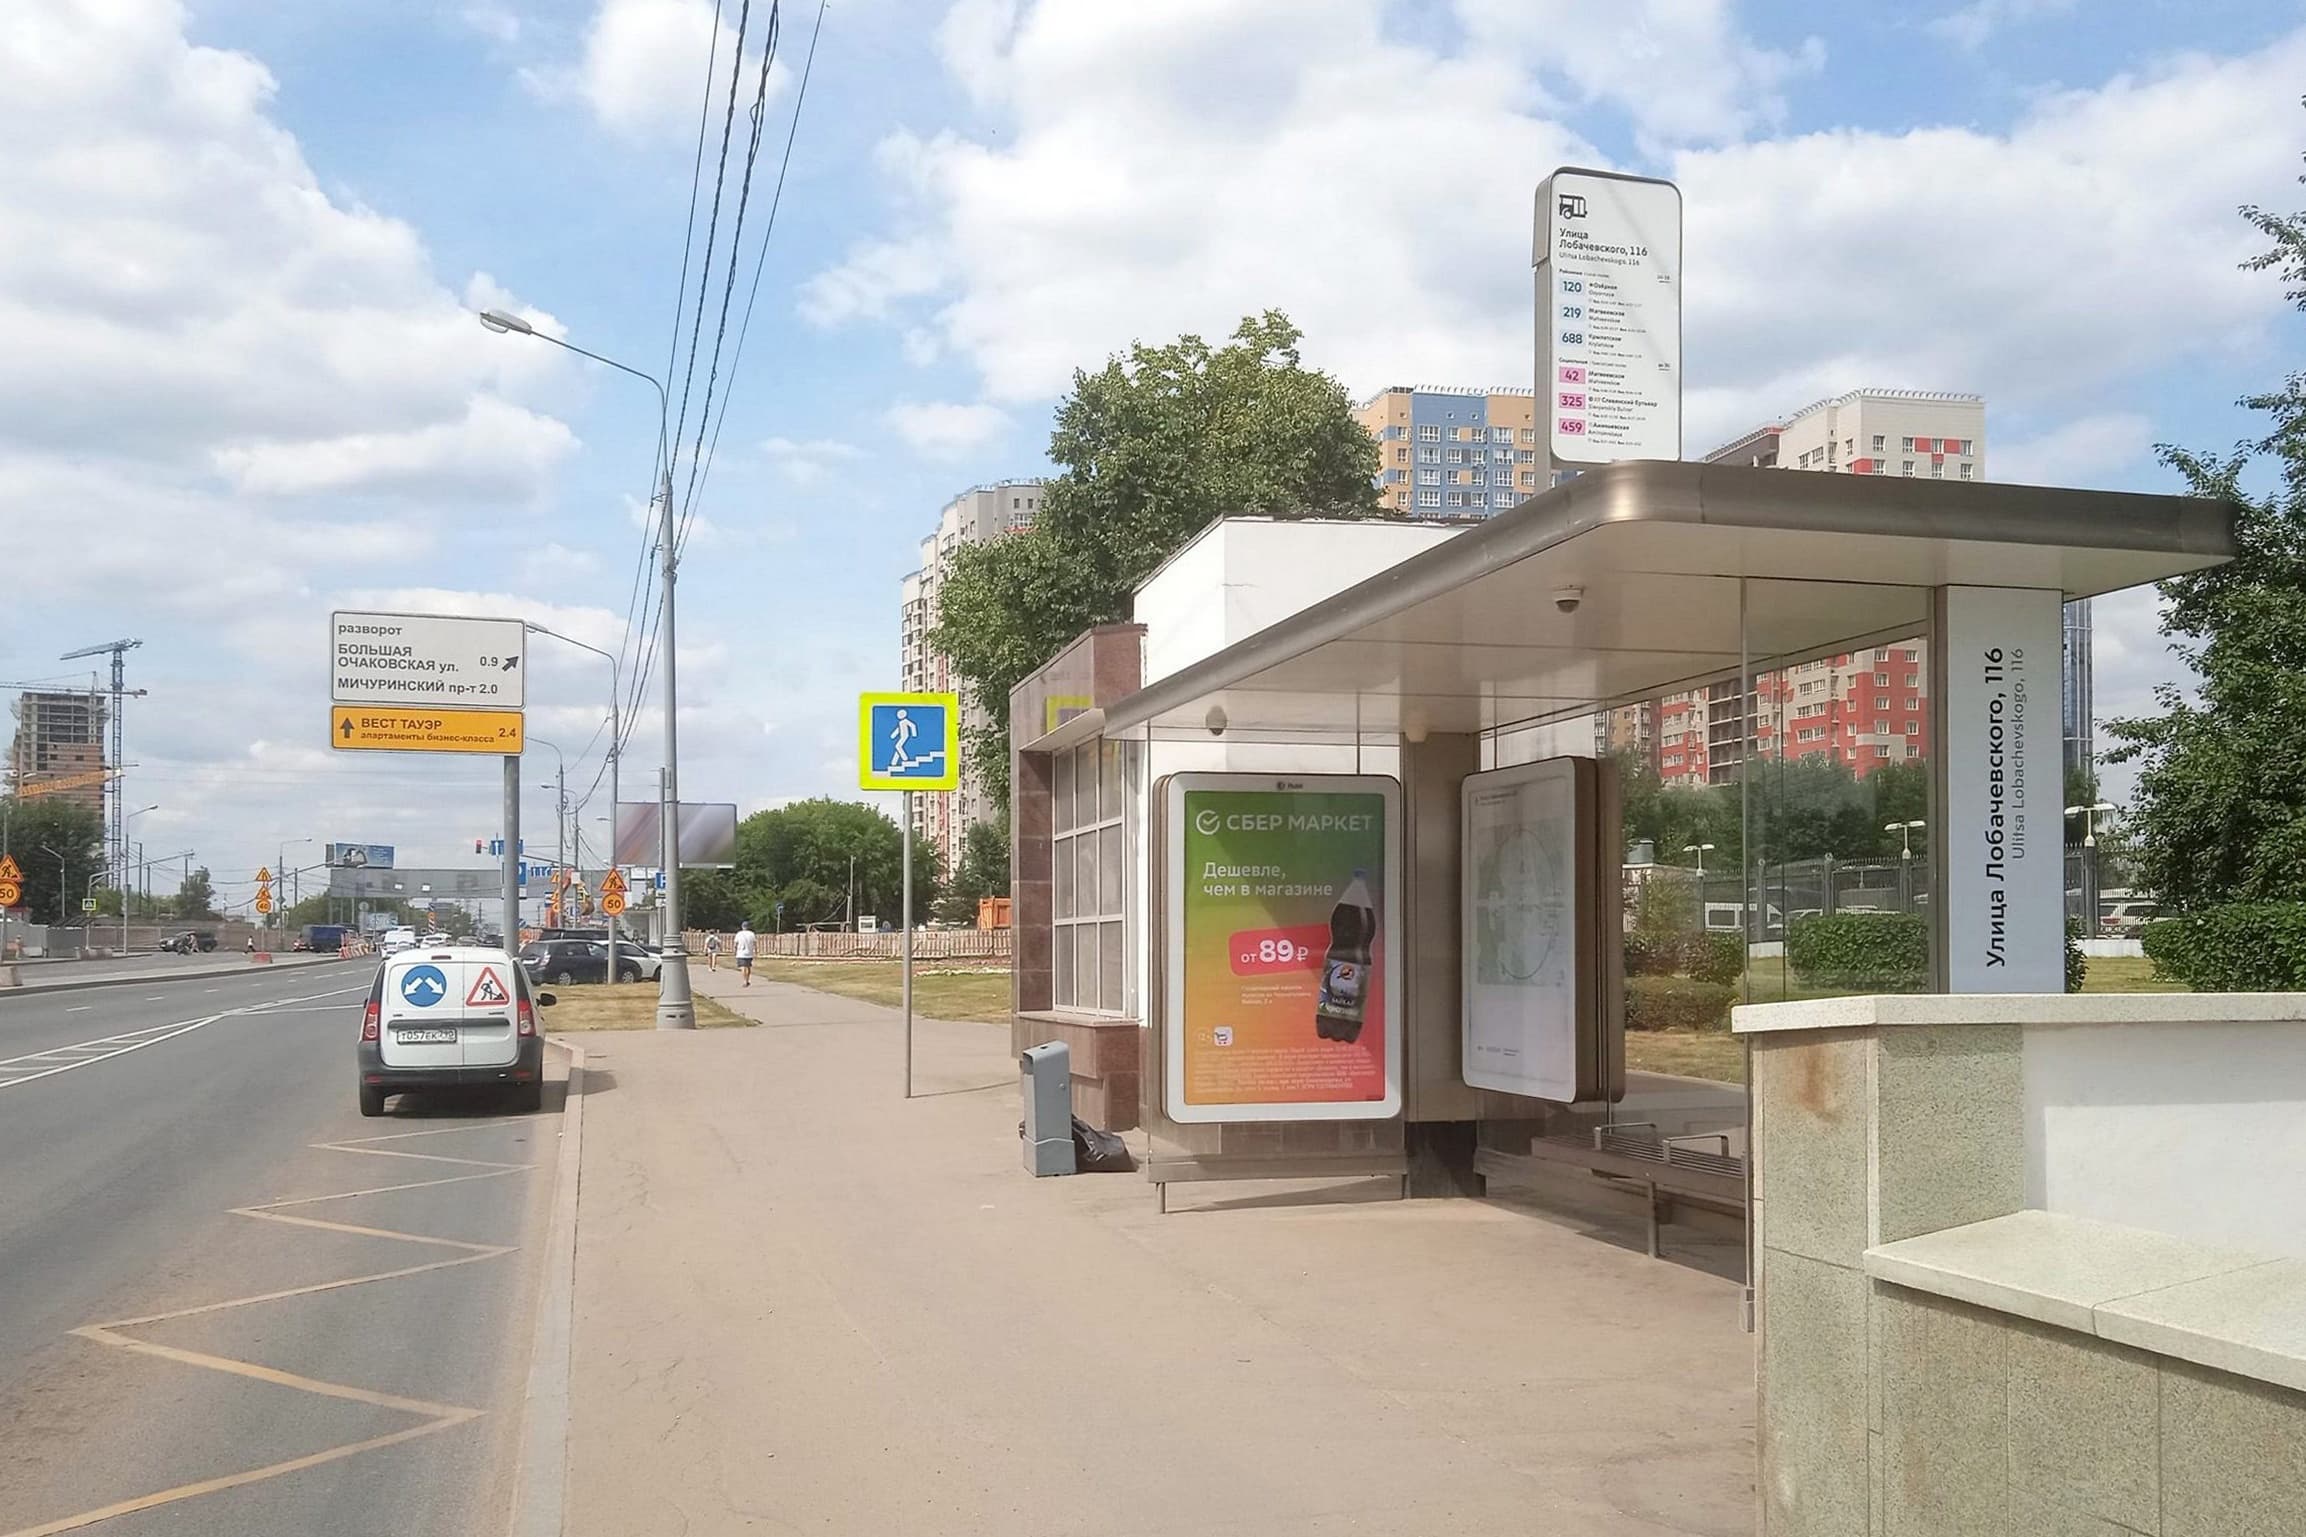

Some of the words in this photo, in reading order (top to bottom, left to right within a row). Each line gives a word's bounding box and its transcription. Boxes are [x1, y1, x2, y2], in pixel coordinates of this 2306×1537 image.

[1559, 228, 1589, 240] Улица
[1559, 239, 1628, 256] Лобачевского,
[1630, 246, 1648, 257] 116
[1563, 281, 1582, 293] 120
[1563, 307, 1582, 318] 219
[1562, 332, 1583, 344] 688
[1565, 370, 1579, 382] 42
[1561, 395, 1583, 407] 325
[1561, 421, 1582, 433] 459
[338, 624, 402, 637] разворот
[338, 643, 412, 657] БОЛЬШАЯ
[338, 656, 435, 671] ОЧАКОВСКАЯ
[439, 662, 459, 674] ул.
[480, 656, 498, 667] 0.9
[1985, 646, 2003, 684] 116
[2011, 647, 2024, 673] 116
[338, 678, 445, 693] МИЧУРИНСКИЙ
[449, 683, 476, 695] пр-т
[479, 683, 498, 695] 2.0
[361, 718, 397, 729] ВЕСТ
[400, 719, 442, 730] ТАУЭР
[361, 732, 425, 741] апартаменты
[426, 732, 495, 743] бизнес-класса
[498, 728, 516, 738] 2.4
[2011, 677, 2028, 808] Lobachevskogo,
[1985, 692, 2007, 882] Лобачевского,
[1226, 814, 1282, 831] СБЕР
[1288, 815, 1373, 832] МАРКЕТ
[2011, 814, 2025, 860] Ulitsa
[1203, 862, 1286, 879] Дешевле,
[0, 888, 15, 899] 50
[1203, 884, 1236, 896] чем
[1240, 884, 1250, 896] в
[1255, 883, 1333, 896] магазине
[607, 899, 621, 909] 50
[1986, 890, 2006, 968] Улица
[1241, 954, 1257, 964] от
[1259, 939, 1294, 963] 89
